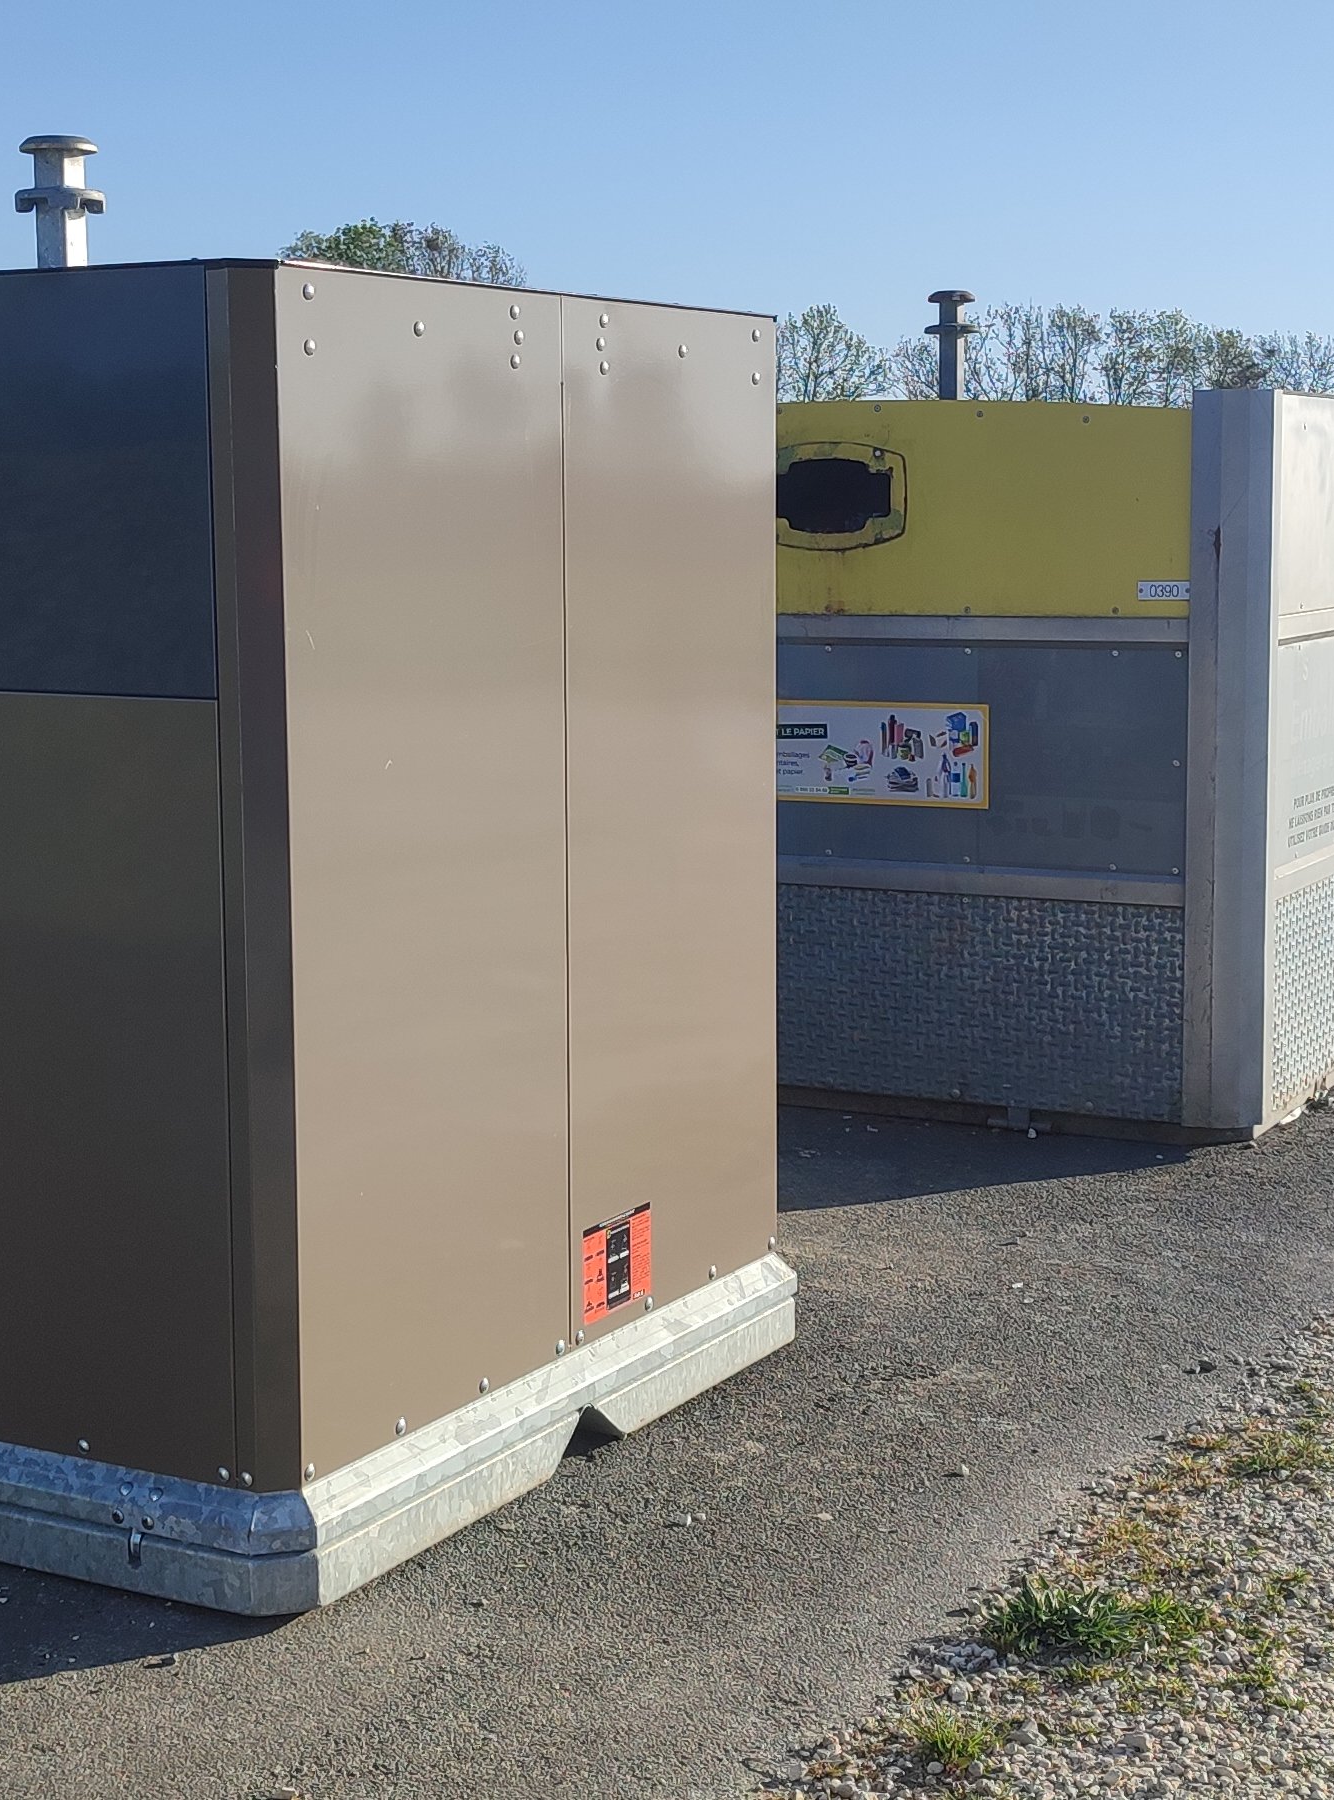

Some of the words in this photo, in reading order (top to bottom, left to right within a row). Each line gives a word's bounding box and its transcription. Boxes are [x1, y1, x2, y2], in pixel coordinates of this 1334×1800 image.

[1149, 584, 1180, 598] 0390
[781, 727, 793, 736] LE
[793, 727, 825, 736] PAPIER
